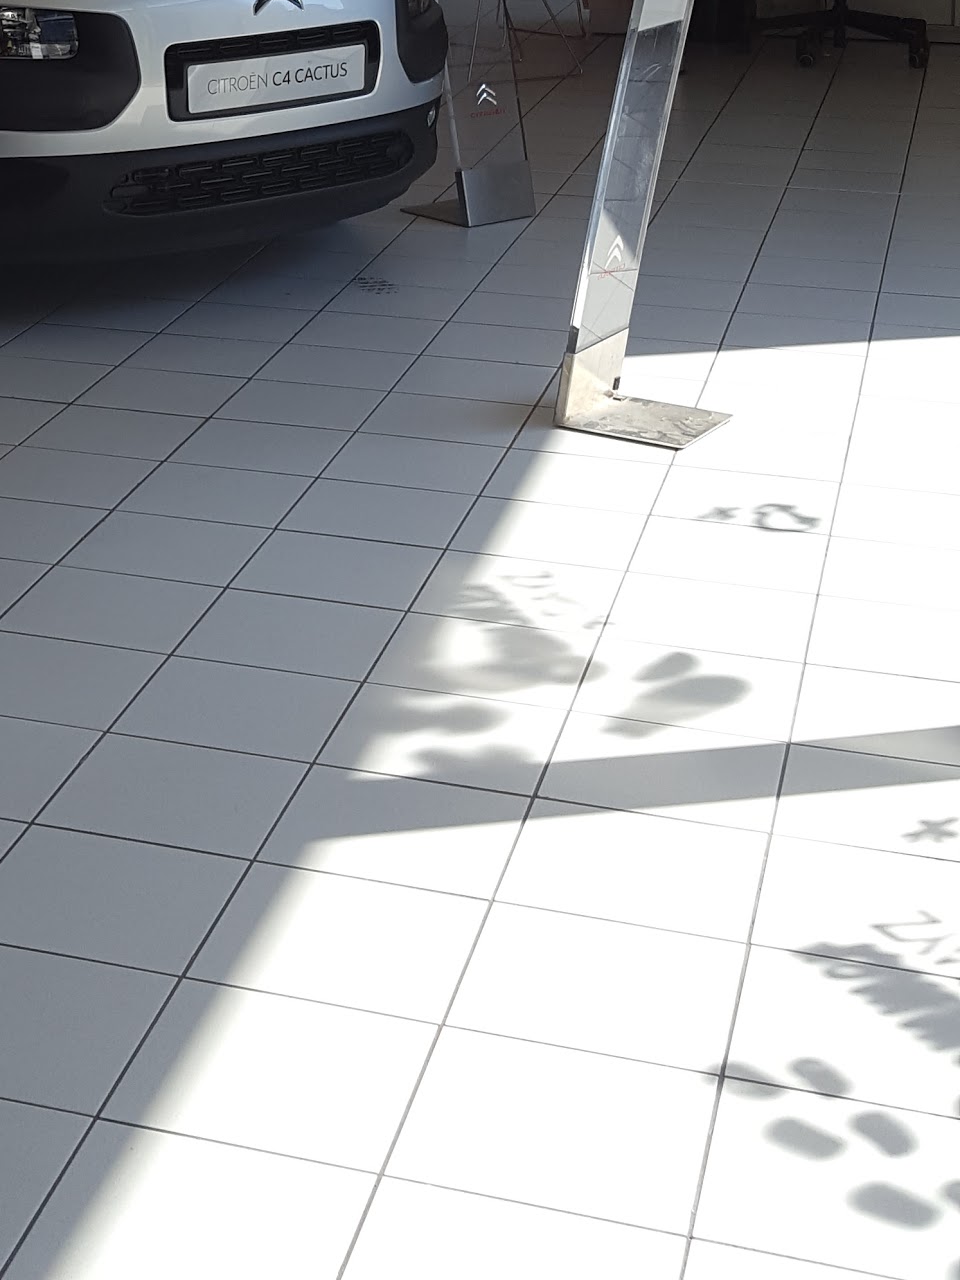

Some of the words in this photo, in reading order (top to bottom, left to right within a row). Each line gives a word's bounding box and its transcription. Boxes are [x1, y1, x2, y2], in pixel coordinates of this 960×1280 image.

[207, 72, 268, 95] CITROËN
[272, 71, 291, 87] C4
[294, 62, 348, 84] CACTUS
